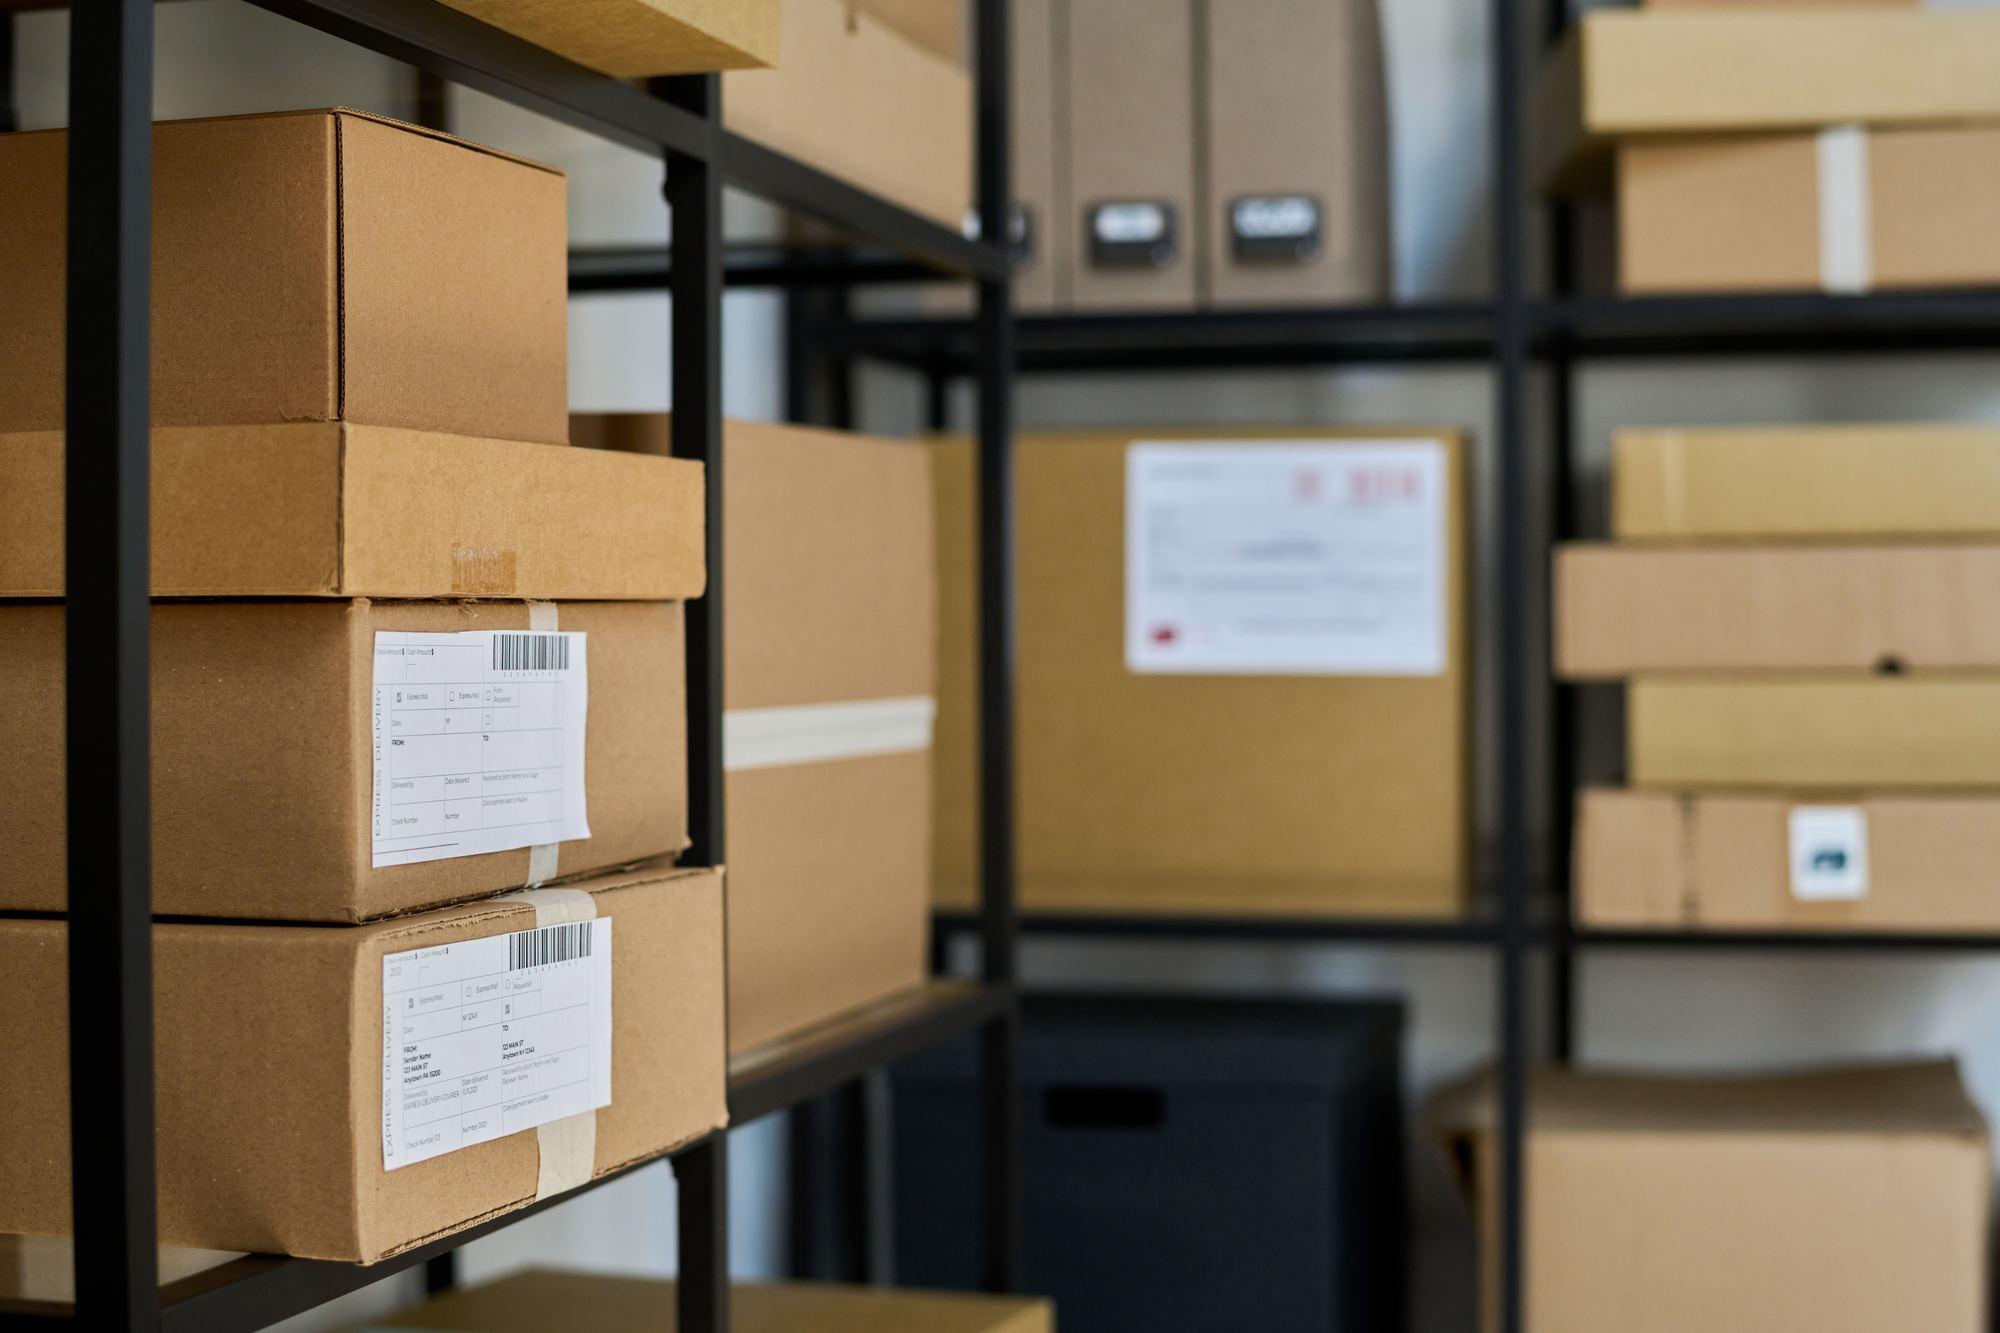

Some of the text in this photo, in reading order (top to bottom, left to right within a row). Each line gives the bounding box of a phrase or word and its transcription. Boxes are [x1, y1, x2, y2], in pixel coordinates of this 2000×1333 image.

[509, 1041, 518, 1049] MAIN
[404, 1053, 431, 1064] Sender Name
[502, 1051, 519, 1060] Anytown
[404, 1074, 422, 1084] Anytown
[385, 1089, 393, 1156] EXPRESS
